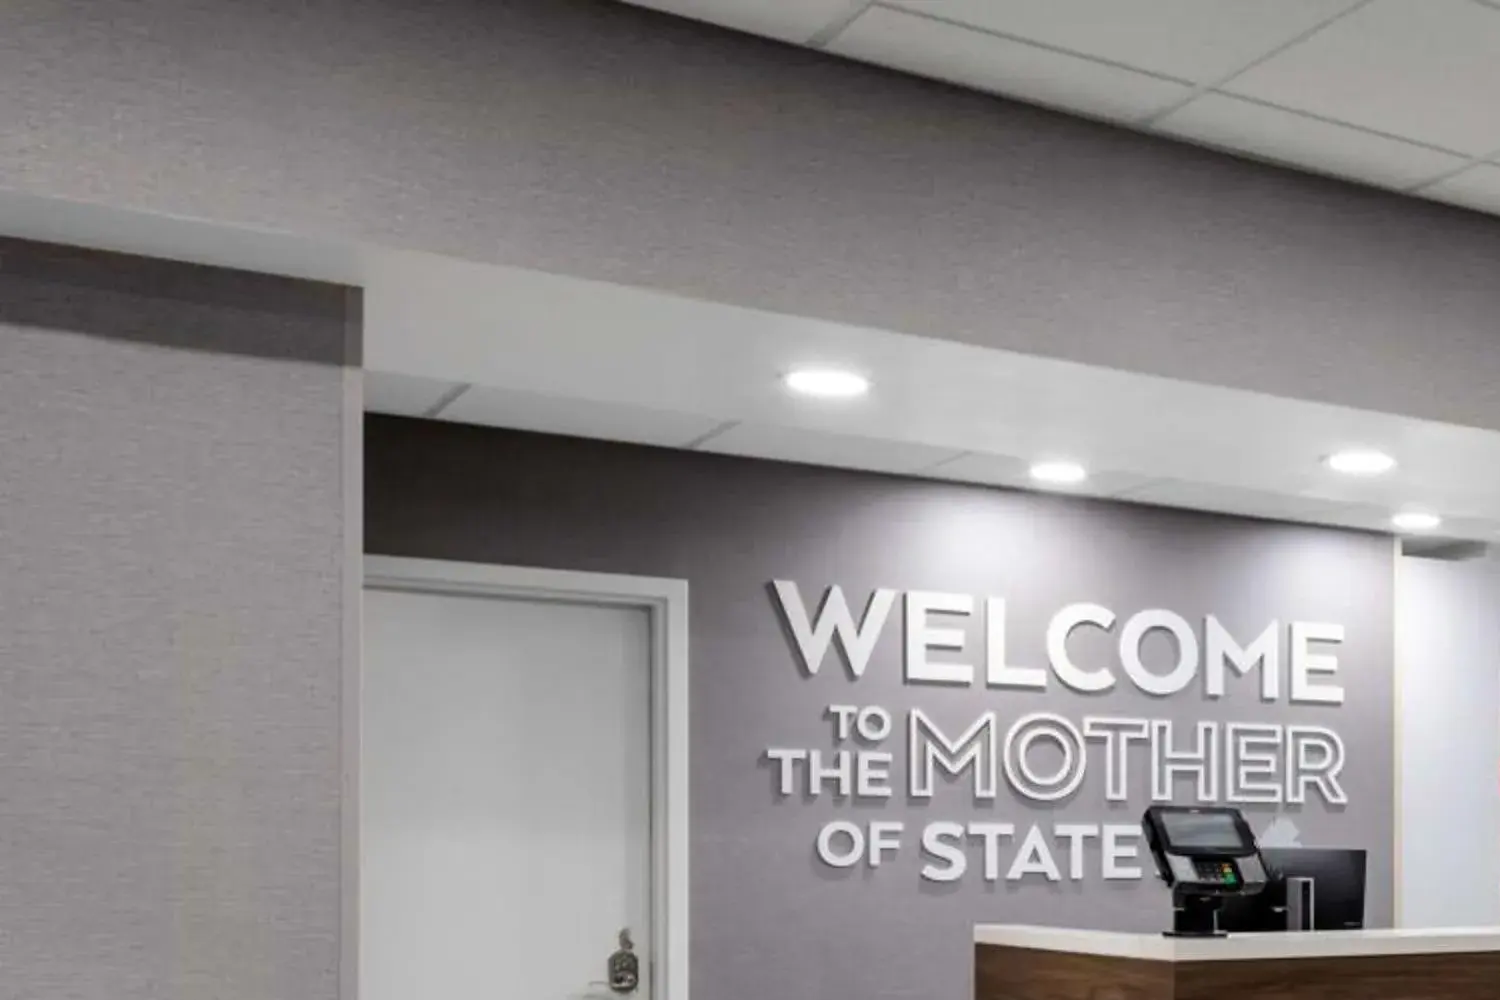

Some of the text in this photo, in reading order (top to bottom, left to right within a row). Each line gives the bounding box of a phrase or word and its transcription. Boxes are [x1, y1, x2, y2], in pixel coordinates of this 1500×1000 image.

[772, 579, 1345, 703] WELCOME
[766, 708, 1349, 805] THE MOTHER
[829, 705, 892, 741] TO
[816, 821, 1162, 883] OF STATE
